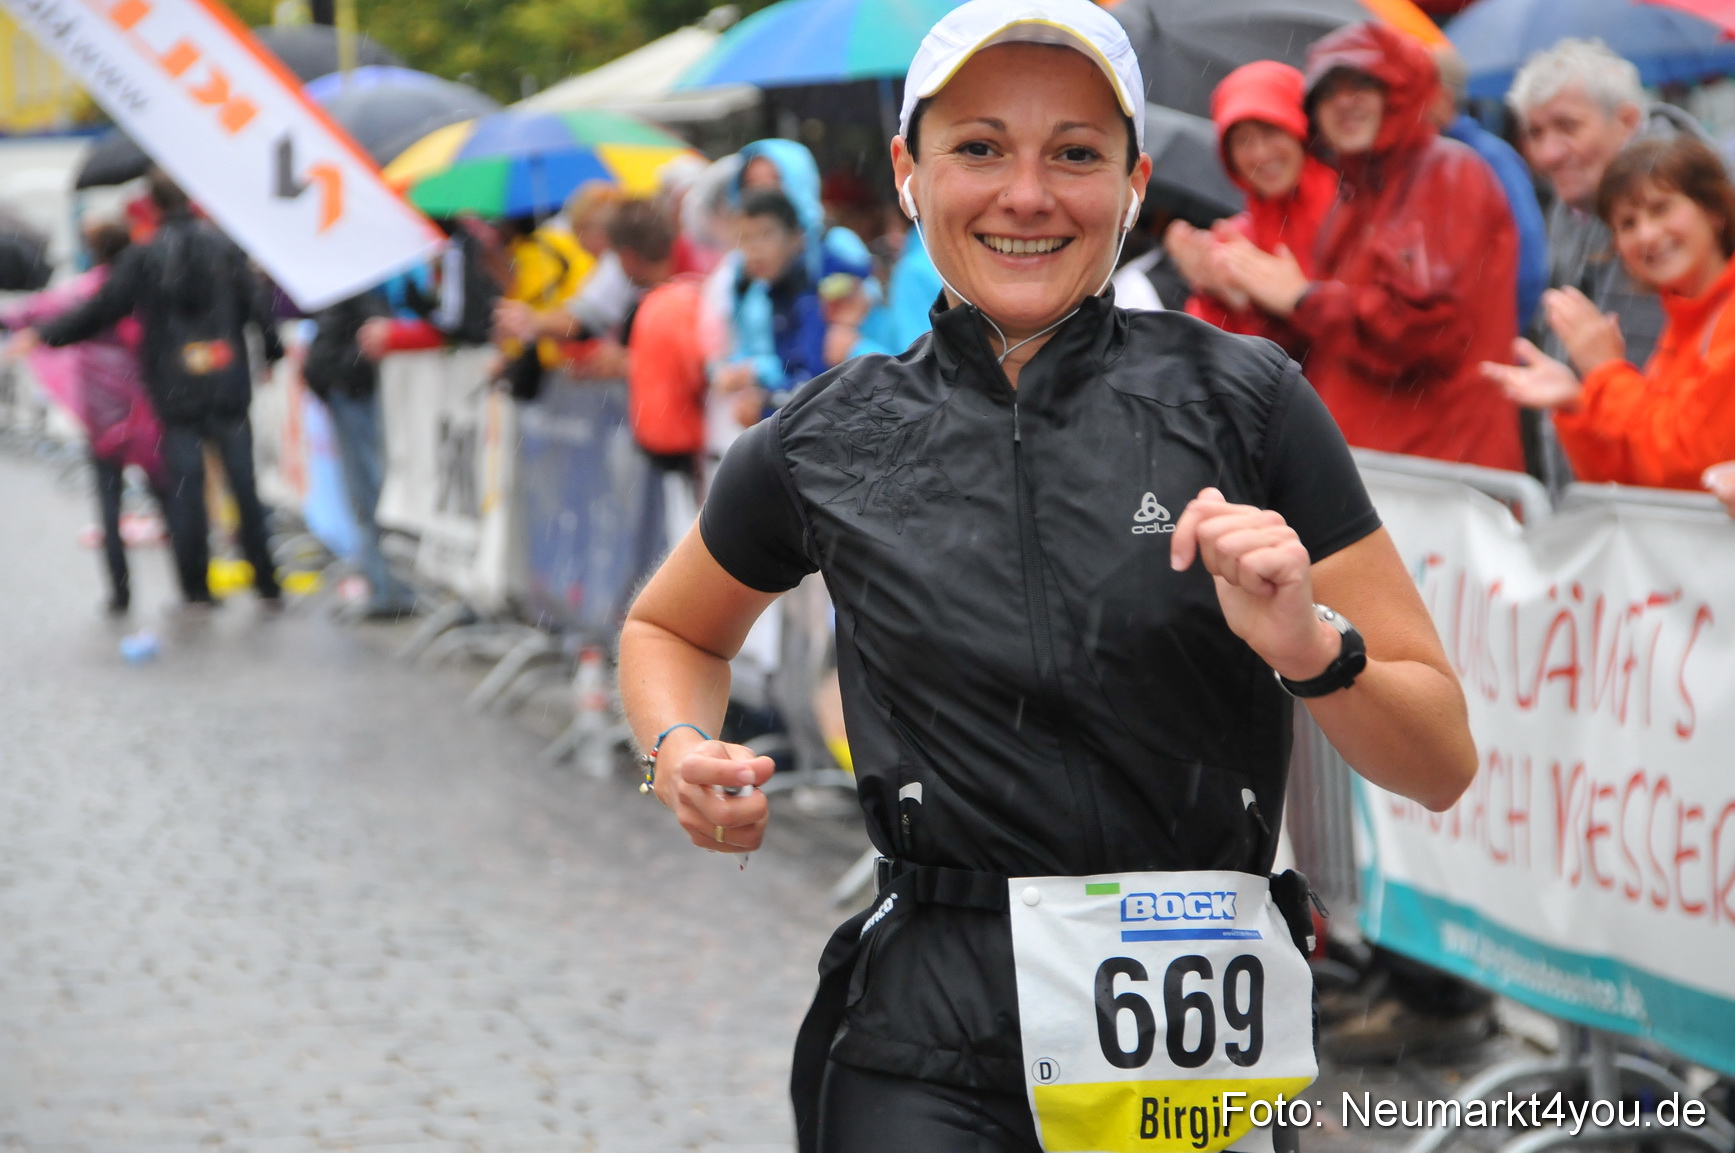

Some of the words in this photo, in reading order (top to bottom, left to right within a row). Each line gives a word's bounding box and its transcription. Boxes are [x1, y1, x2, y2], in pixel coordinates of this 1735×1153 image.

[1131, 522, 1176, 534] odlo
[1551, 759, 1735, 927] BESSER
[1120, 891, 1237, 922] BOCK
[1094, 953, 1265, 1069] 669
[1039, 1061, 1052, 1081] D
